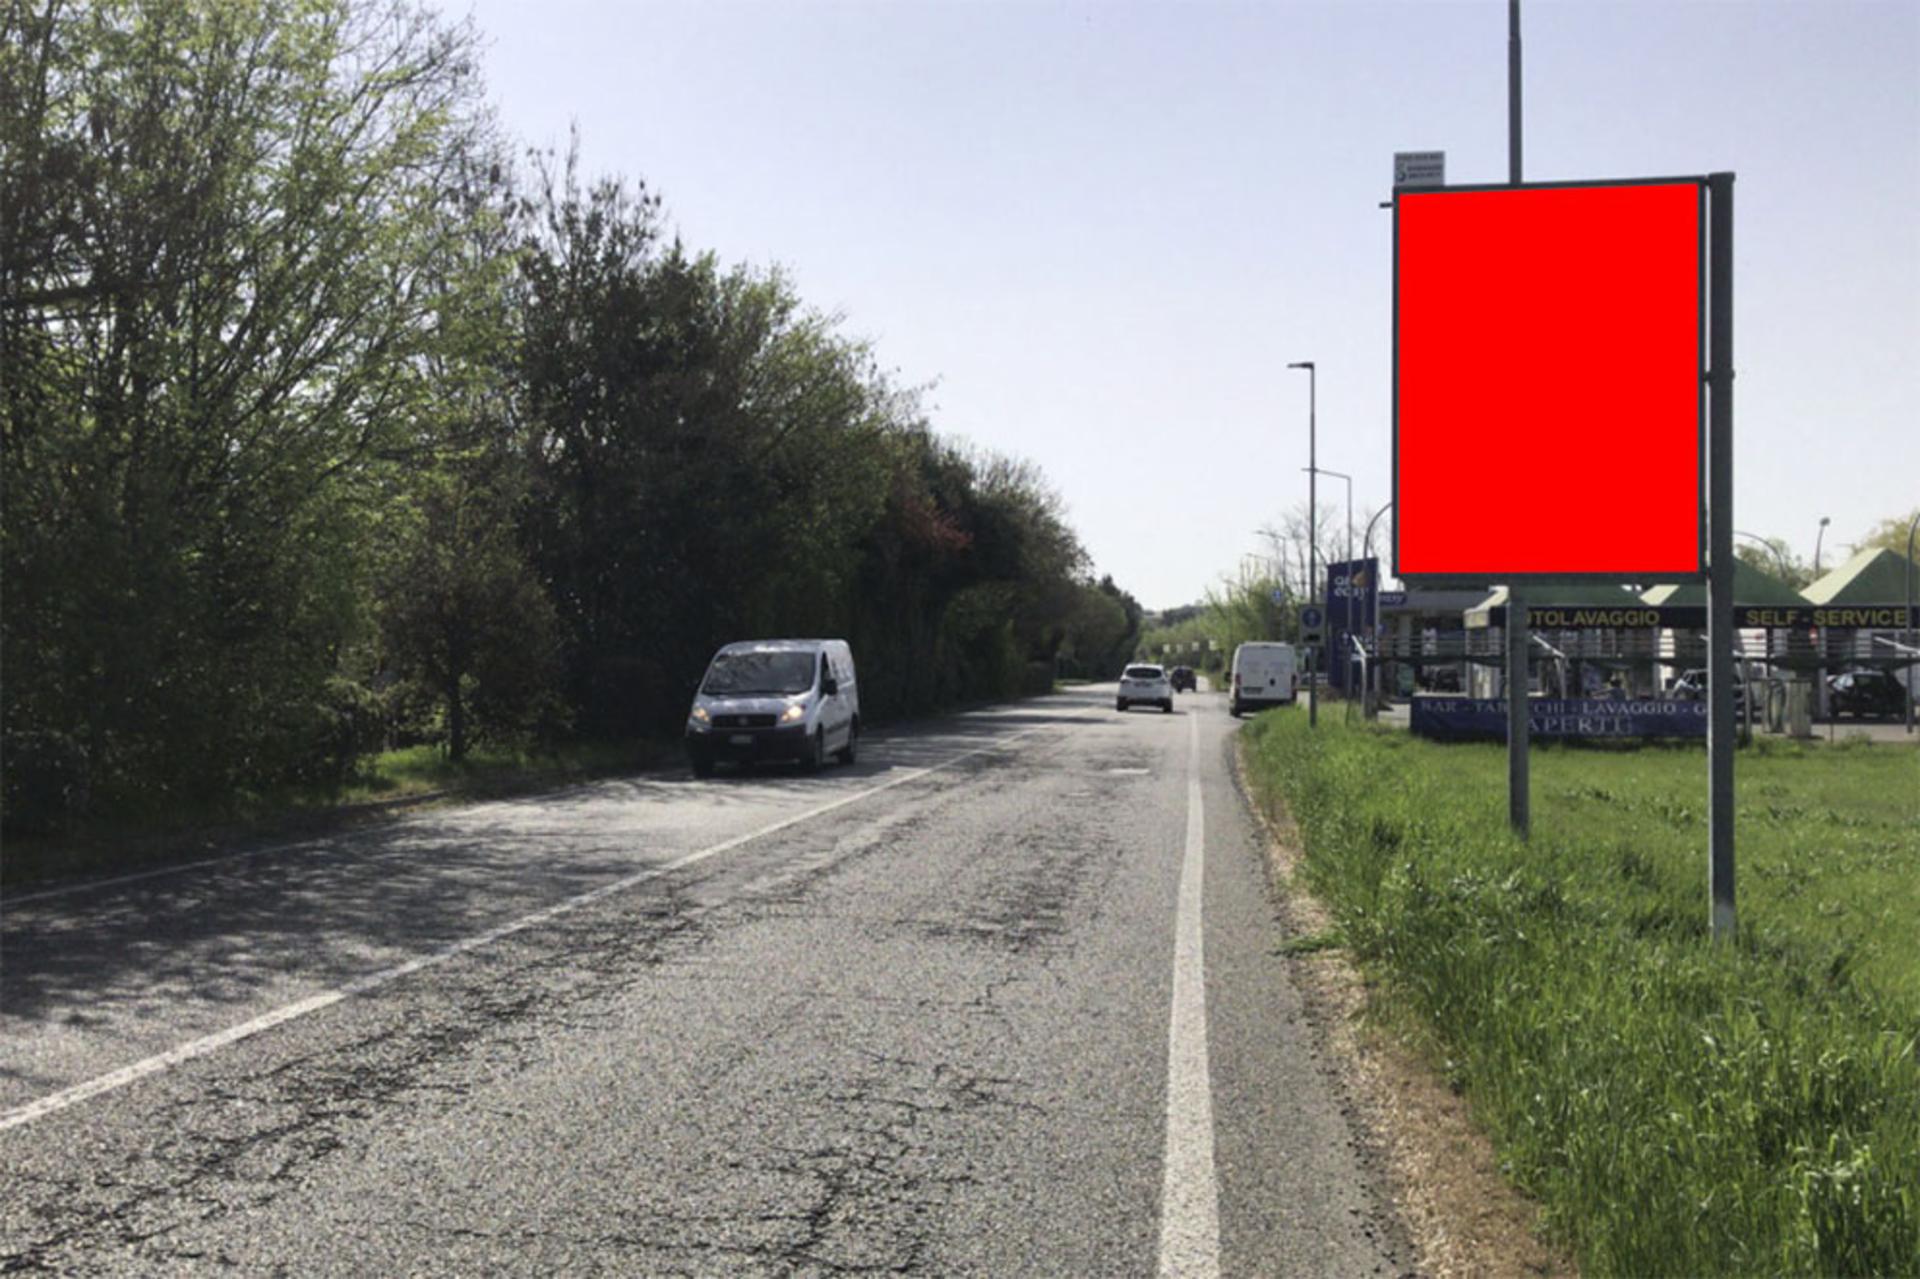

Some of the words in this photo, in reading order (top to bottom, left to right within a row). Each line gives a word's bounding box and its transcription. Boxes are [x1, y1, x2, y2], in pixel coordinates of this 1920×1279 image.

[1526, 610, 1660, 626] TOLAVAGGIO
[1746, 610, 1798, 625] SELF
[1813, 609, 1906, 626] SERVICE
[1582, 702, 1677, 715] LAVAGGIO
